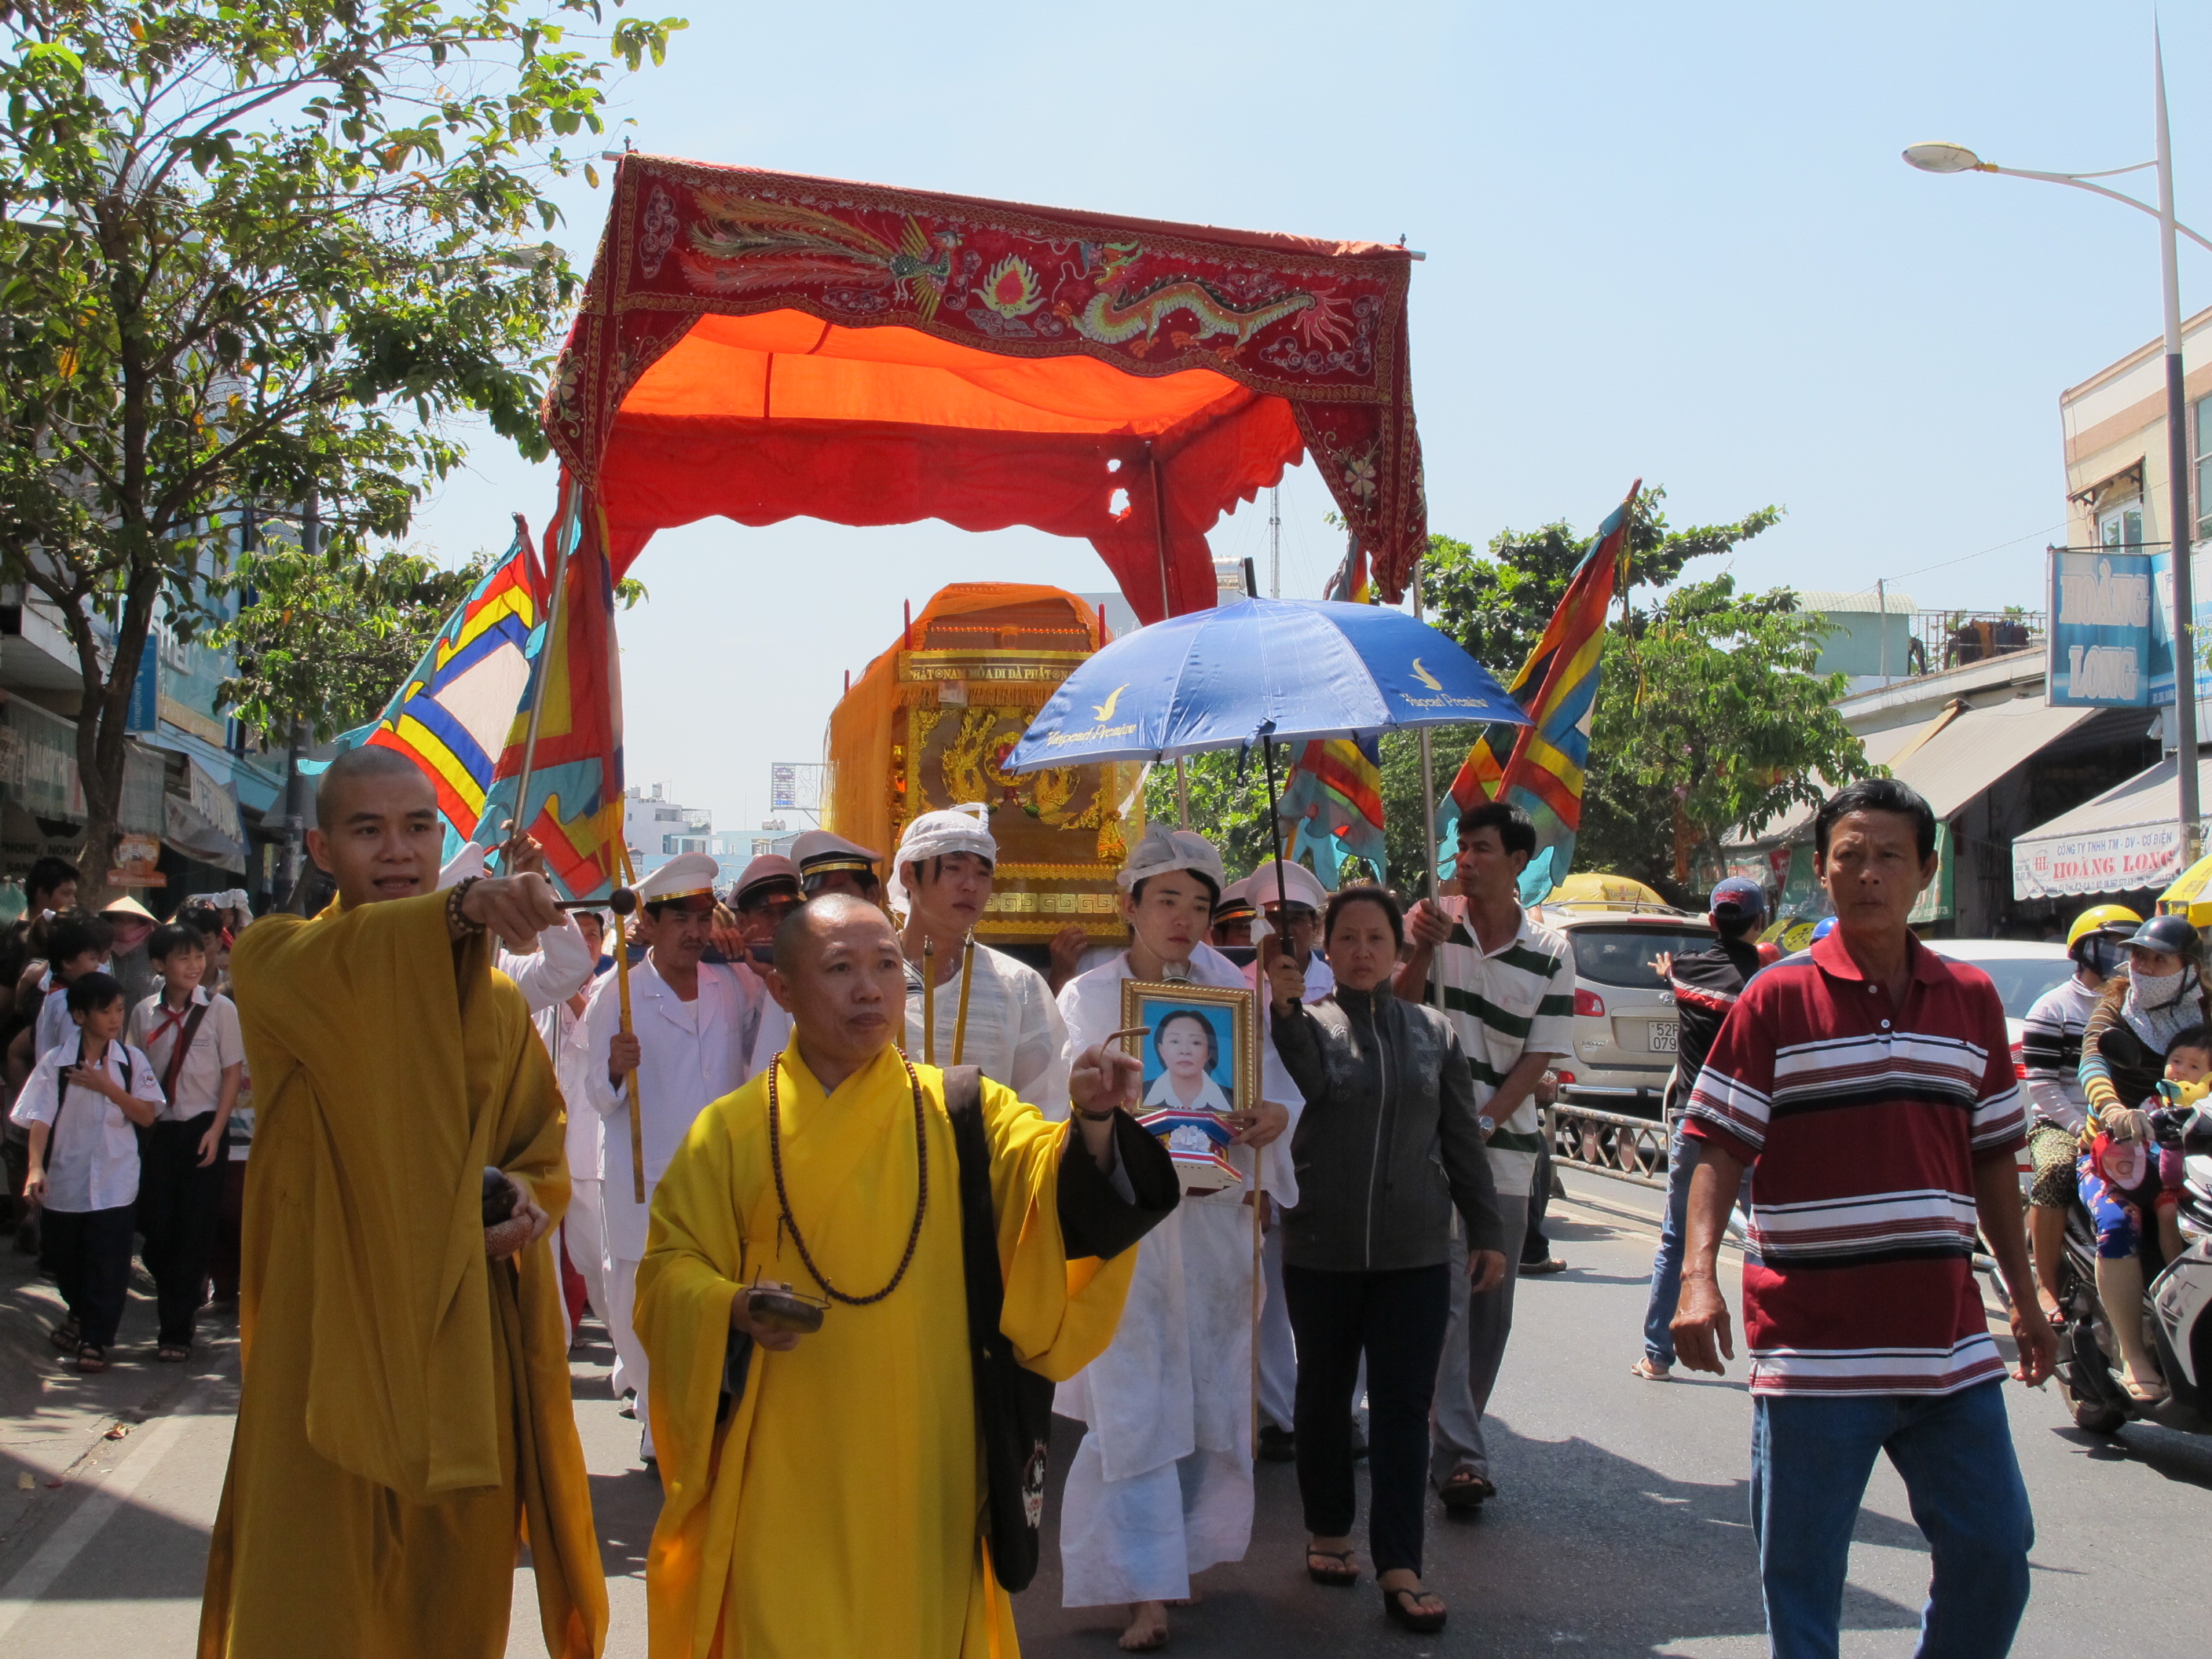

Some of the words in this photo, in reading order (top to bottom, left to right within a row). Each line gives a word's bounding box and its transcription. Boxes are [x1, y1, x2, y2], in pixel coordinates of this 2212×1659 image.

[985, 668, 993, 679] A
[994, 668, 1006, 679] DI
[1024, 666, 1051, 681] PHẬT
[2068, 645, 2140, 700] LONG
[134, 681, 143, 729] vinaphone
[1439, 693, 1489, 708] Premium
[1092, 723, 1137, 740] Premium
[2056, 842, 2075, 856] CÔNG
[2077, 843, 2086, 854] TY
[2087, 840, 2106, 853] TNHH
[2108, 838, 2119, 850] TM
[2125, 837, 2135, 848] DV
[2153, 830, 2173, 847] ĐIỆN
[2053, 856, 2115, 881] HOÀNG
[2122, 849, 2176, 874] LONG
[1654, 1036, 1677, 1050] 079
